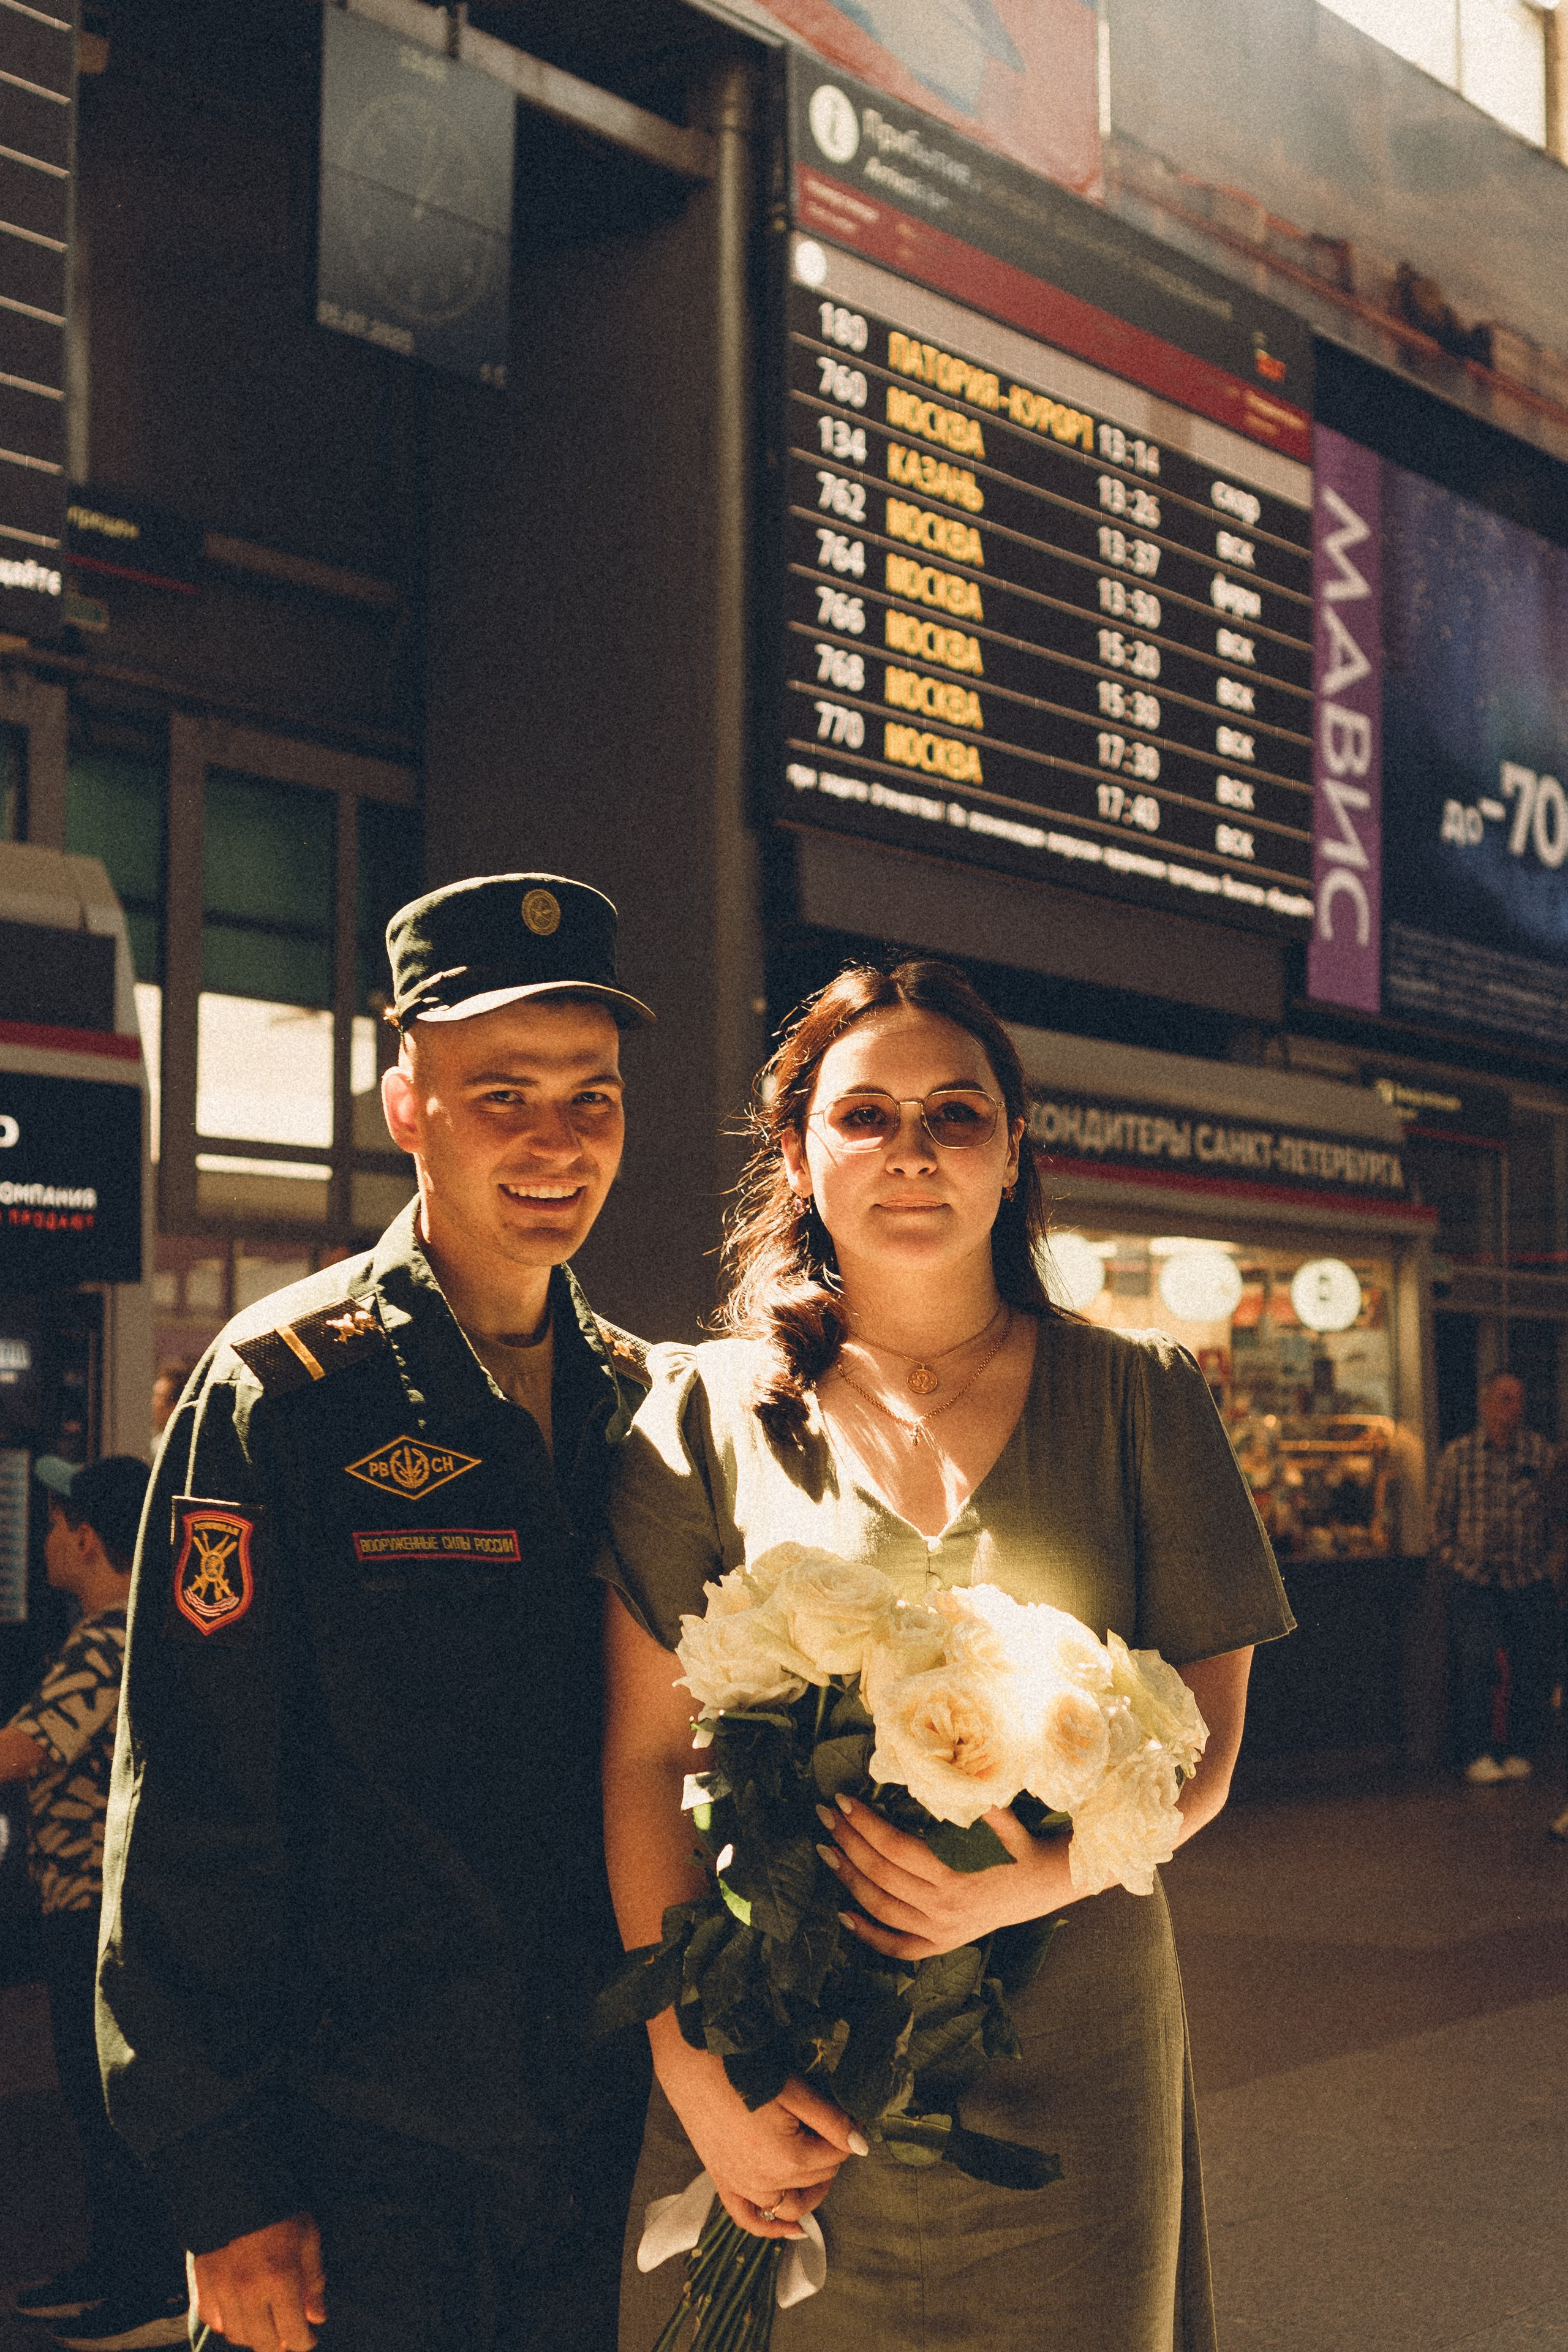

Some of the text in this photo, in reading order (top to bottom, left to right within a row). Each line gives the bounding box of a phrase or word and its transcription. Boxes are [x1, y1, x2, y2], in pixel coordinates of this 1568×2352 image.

[816, 356, 867, 408] 760
[886, 386, 985, 460] МОСКВА
[1098, 474, 1161, 529] 13:26
[818, 302, 868, 352] 180
[1098, 424, 1160, 478] 13:14
[816, 471, 867, 522] 762
[886, 497, 984, 568] МОСКВА
[1098, 577, 1161, 629] 13:50
[818, 416, 867, 466] 134
[887, 442, 984, 513] КАЗАНЬ
[1098, 526, 1161, 578] 13:37
[815, 586, 865, 635] 766
[885, 608, 984, 676] МОСКВА
[1096, 680, 1161, 730] 15:30
[816, 528, 866, 578] 764
[885, 553, 984, 622] МОСКВА
[1097, 628, 1161, 680] 15:20
[814, 701, 865, 749] 770
[884, 722, 984, 786] МОСКВА
[1096, 783, 1161, 831] 17:40
[815, 643, 865, 692] 768
[884, 665, 984, 729] МОСКВА
[1096, 732, 1161, 781] 17:30
[1321, 485, 1371, 948] МАВИС
[1195, 1123, 1404, 1189] САНКТ-ПЕТЕРБУРГА
[360, 1536, 514, 1553] ВООРУЖЕННЫЕ СИЛЫ РОССИИ
